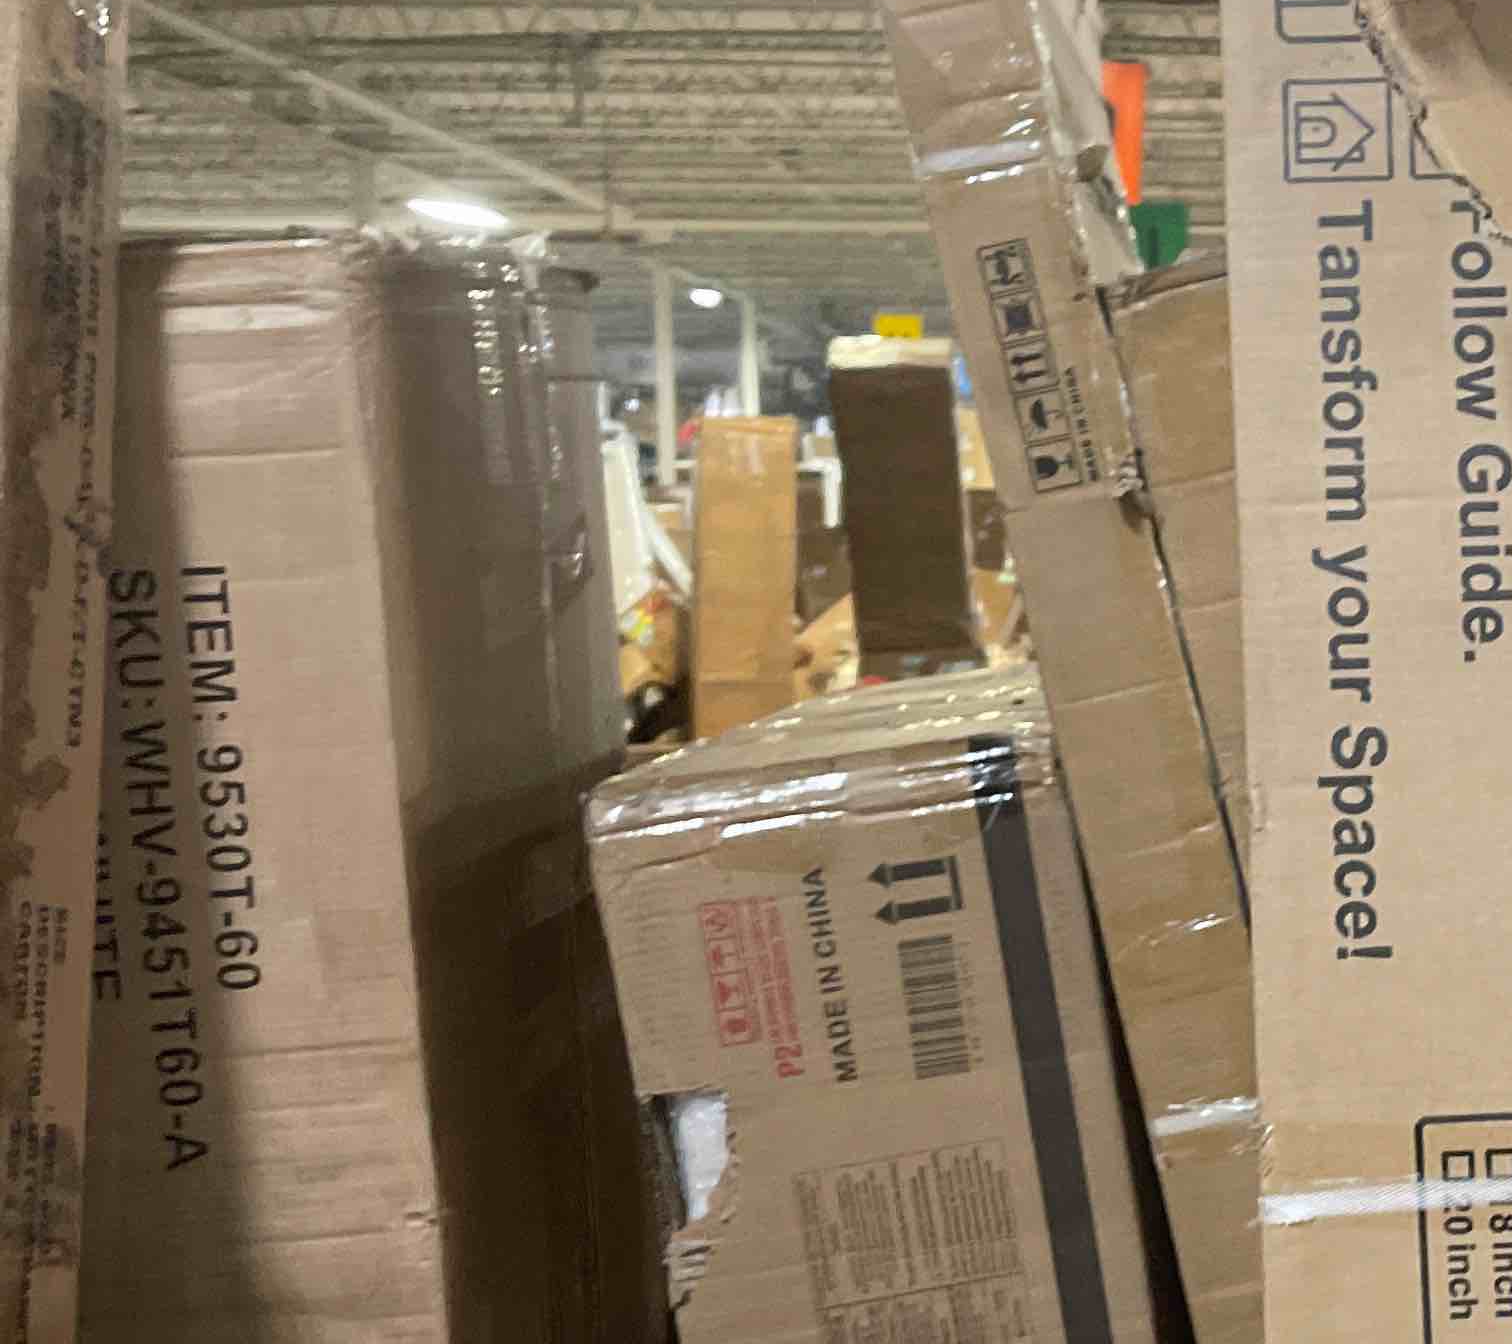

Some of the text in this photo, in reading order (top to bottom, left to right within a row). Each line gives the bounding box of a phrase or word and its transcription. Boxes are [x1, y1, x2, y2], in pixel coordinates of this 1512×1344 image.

[1312, 200, 1393, 960] Tansform your Space!
[180, 565, 261, 992] ITEM: 9530T-60
[801, 867, 858, 1083] MADE IN CHINA
[1448, 1244, 1479, 1320] inch
